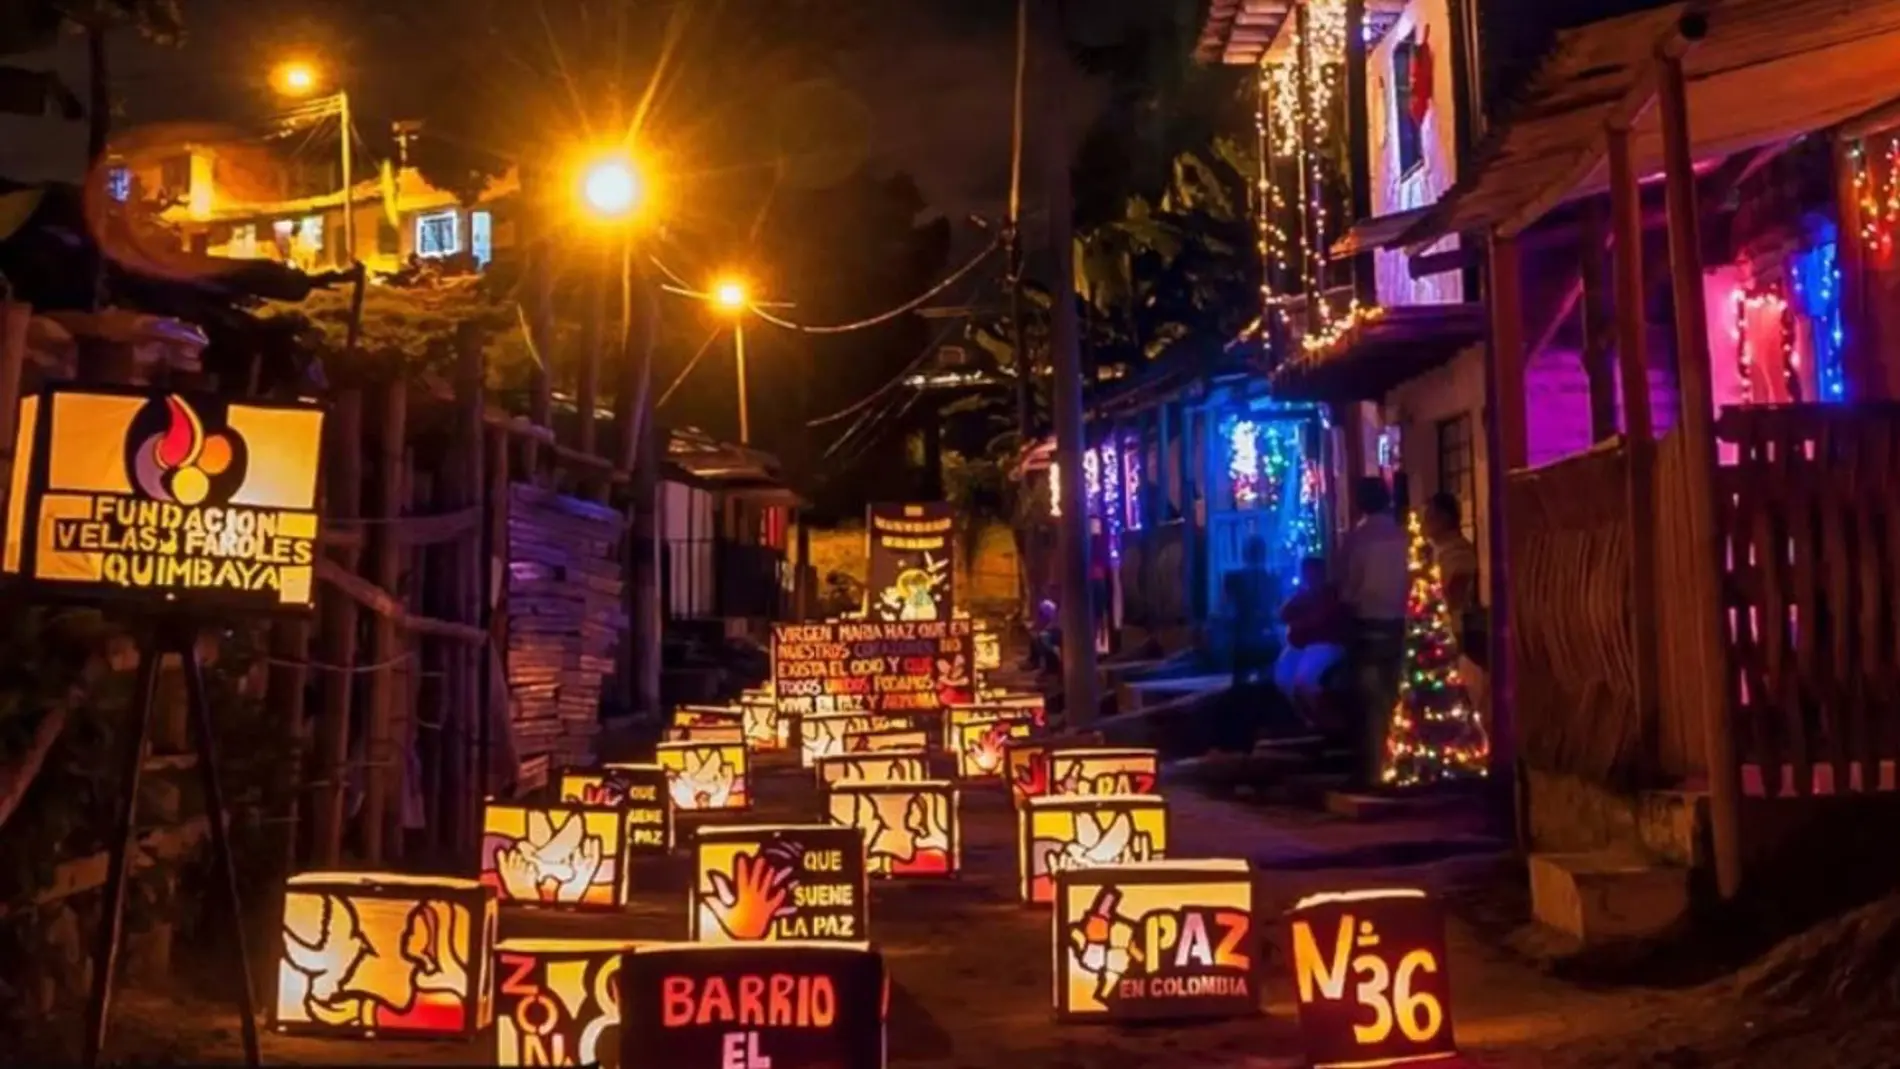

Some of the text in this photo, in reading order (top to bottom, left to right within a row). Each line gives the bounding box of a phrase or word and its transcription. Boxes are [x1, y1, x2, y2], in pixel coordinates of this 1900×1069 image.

[96, 495, 276, 538] FUNDACION
[57, 521, 158, 550] VELAS
[185, 530, 313, 565] FAROLES
[104, 552, 281, 591] QUIMBAYA
[776, 626, 832, 643] VIRGEN
[839, 624, 882, 641] MARIA
[884, 623, 915, 639] HAZ
[918, 621, 946, 638] QUE
[778, 643, 849, 659] NUESTROS
[887, 656, 900, 673] Y
[778, 678, 821, 696] TODOS
[866, 694, 880, 709] Y
[804, 850, 842, 872] QUE
[793, 884, 854, 907] SUENE
[781, 914, 855, 938] LA PAZ
[1144, 911, 1250, 974] PAZ
[1119, 975, 1248, 999] EN COLOMBIA
[1351, 948, 1442, 1045] 36
[662, 974, 836, 1028] BARRIO
[722, 1032, 772, 1069] EL
